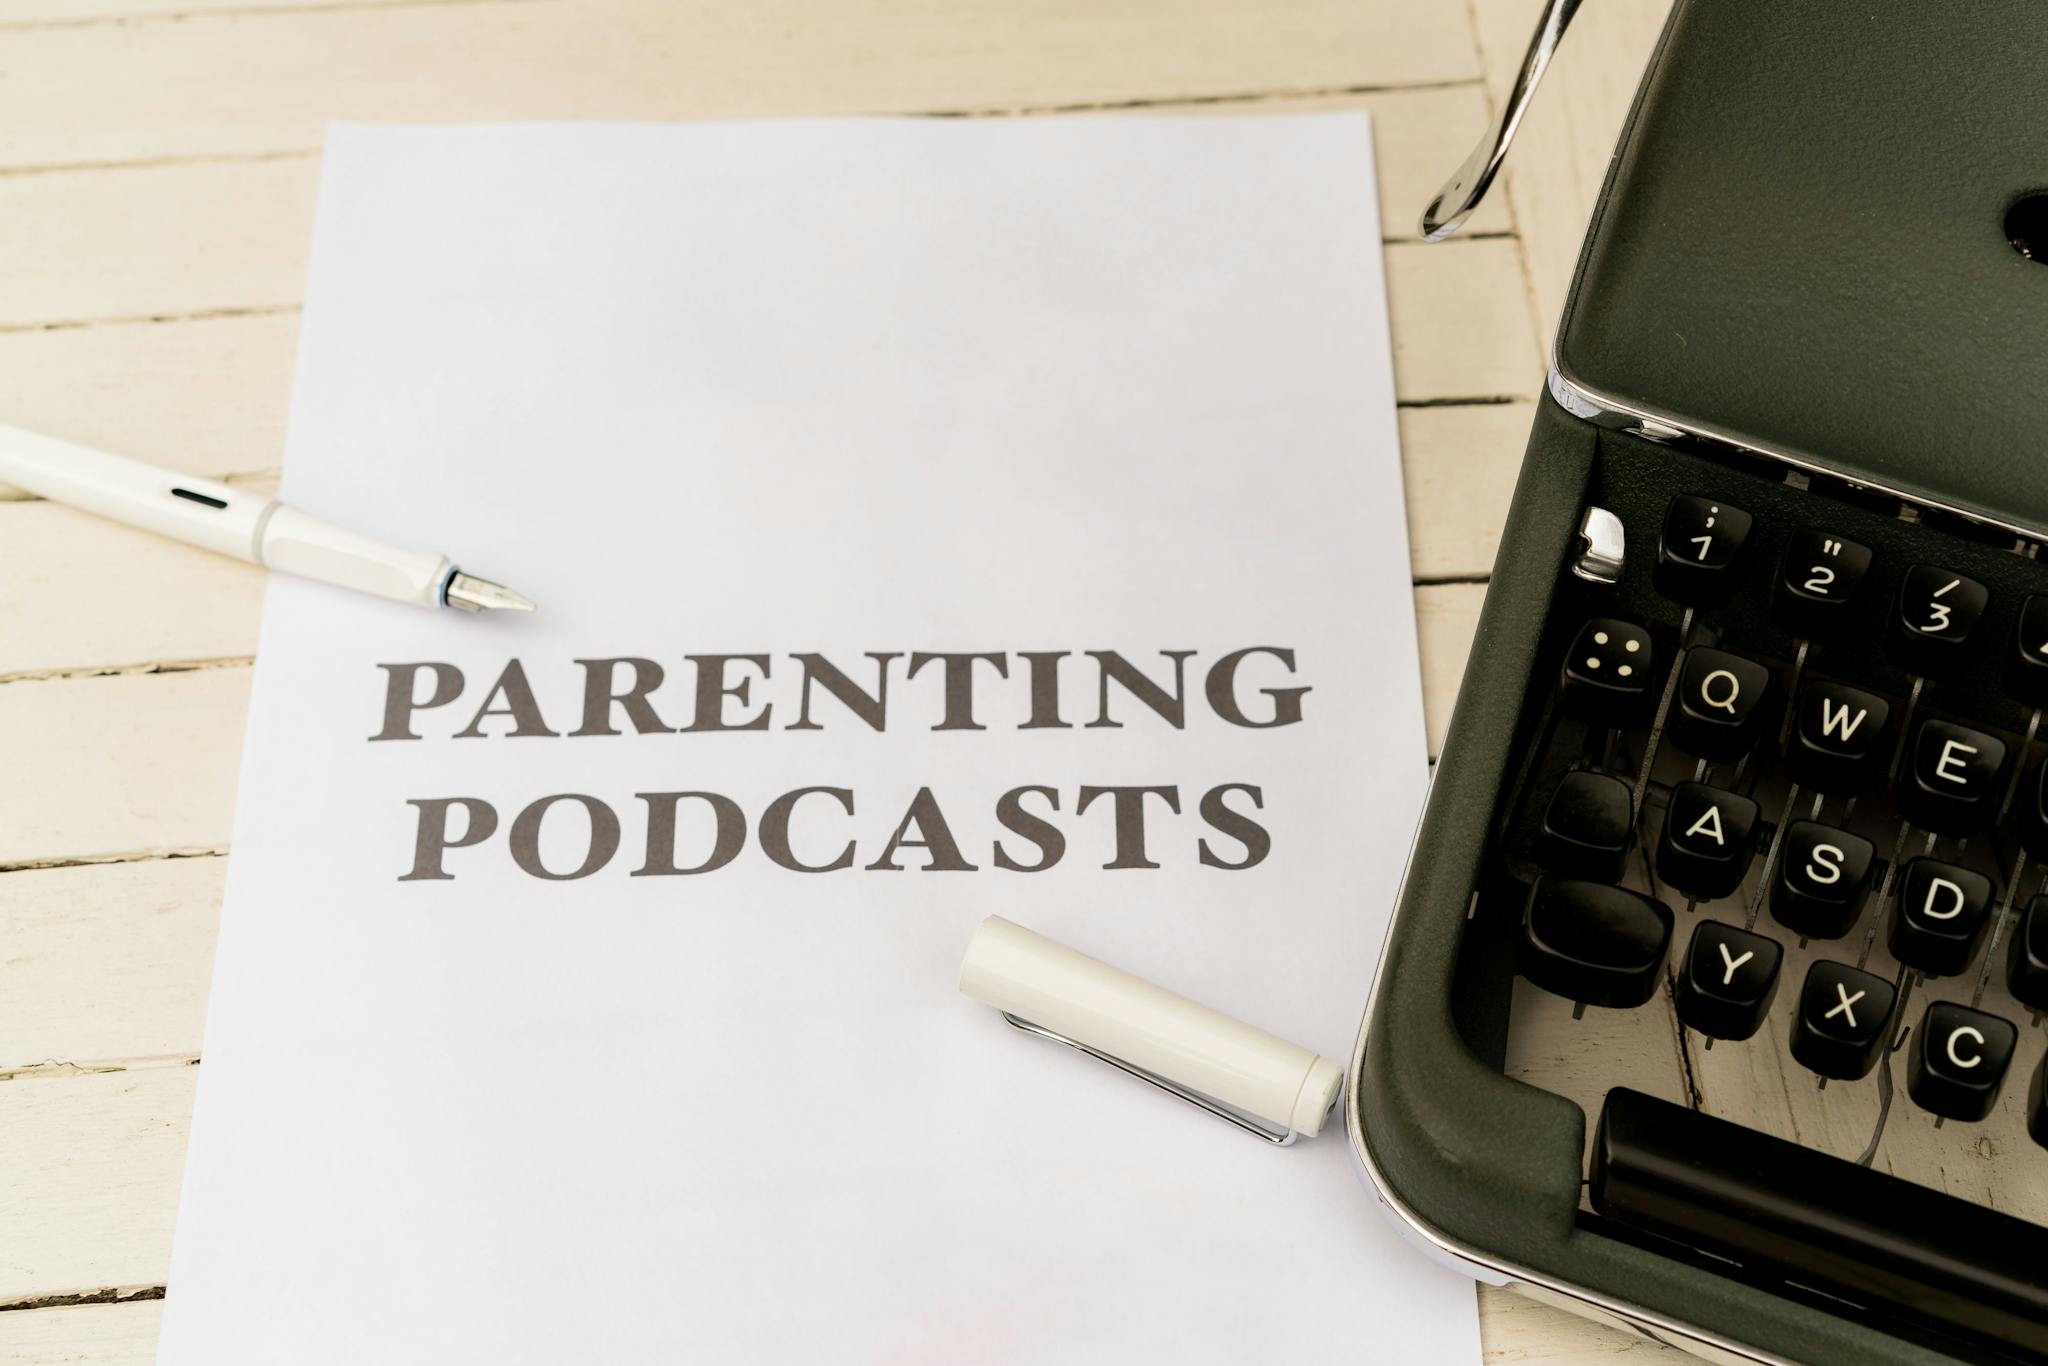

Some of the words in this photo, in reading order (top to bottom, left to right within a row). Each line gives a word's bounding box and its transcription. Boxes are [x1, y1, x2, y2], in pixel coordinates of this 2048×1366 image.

[1690, 535, 1713, 561] 1
[1804, 566, 1835, 594] 2
[1920, 602, 1951, 632] 3
[367, 646, 1313, 742] PARENTING
[1701, 670, 1740, 714] Q
[1823, 698, 1867, 742] W
[1936, 740, 1978, 784] E
[398, 782, 1271, 881] PODCASTS
[1685, 805, 1724, 845] A
[1806, 844, 1845, 884] S
[1923, 877, 1964, 919] D
[1719, 943, 1754, 985] Y
[1825, 983, 1866, 1027] X
[1947, 1026, 1985, 1068] C
